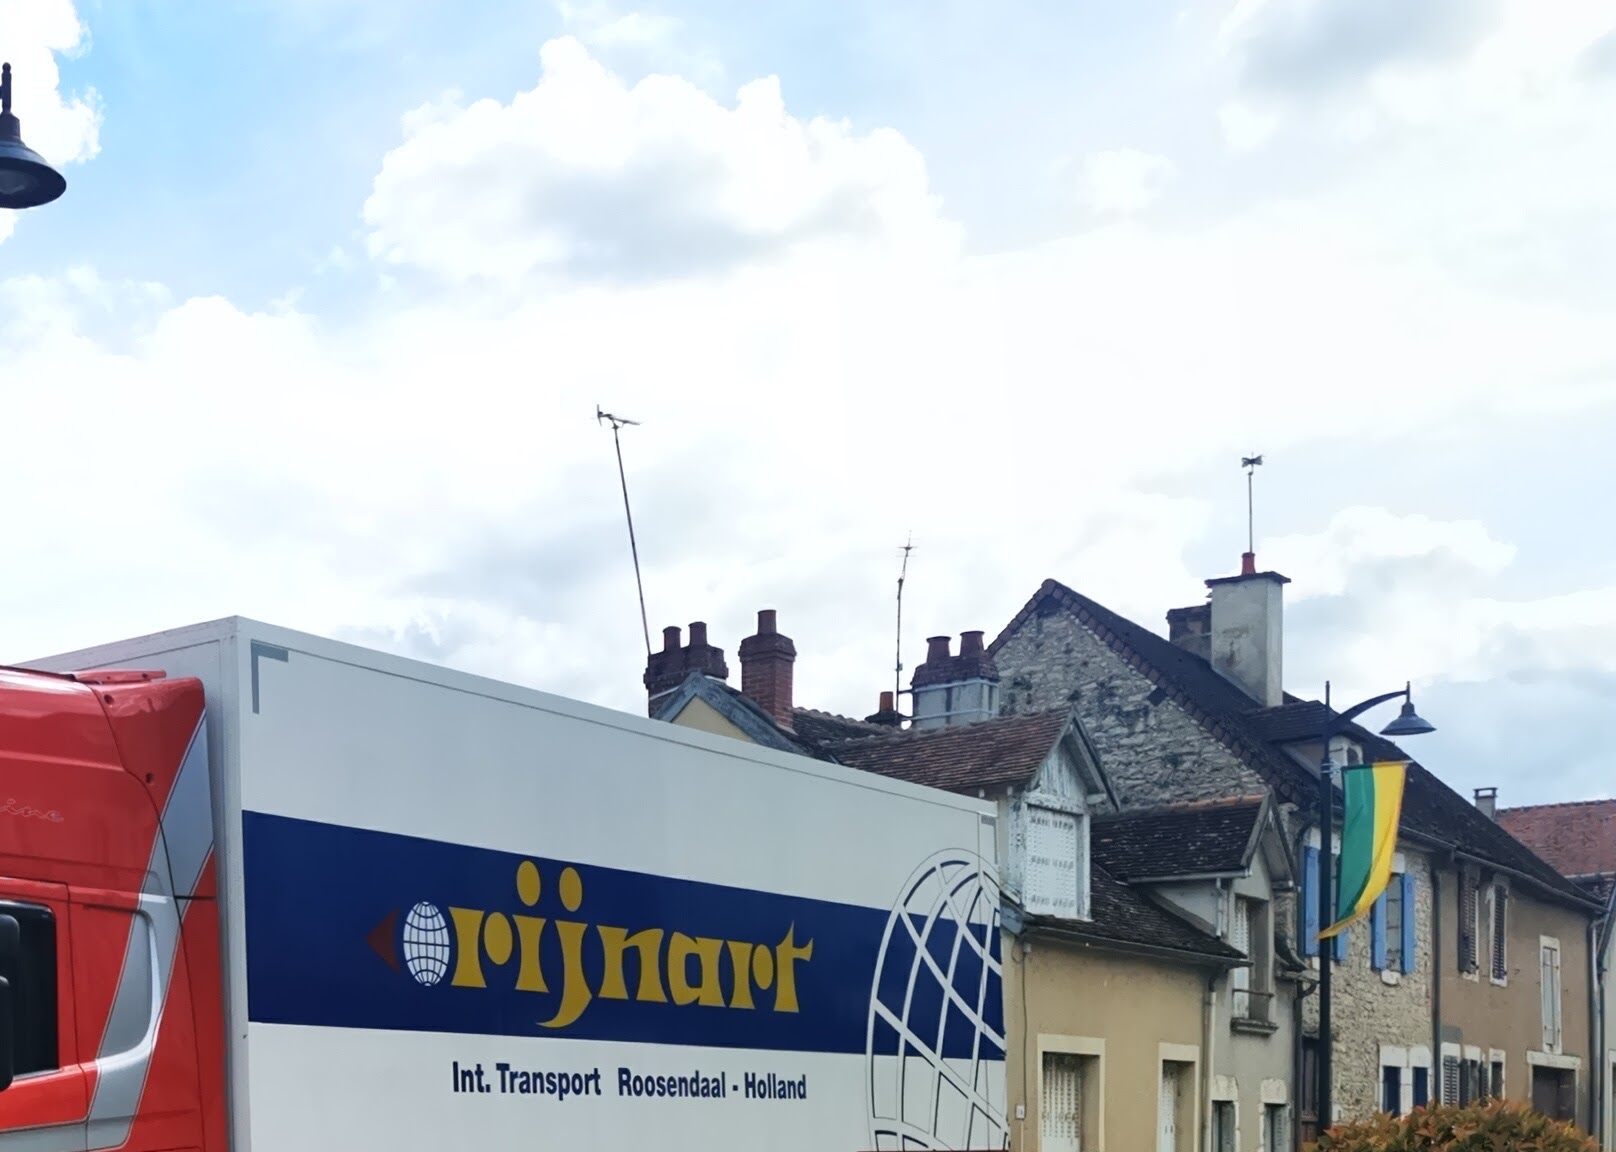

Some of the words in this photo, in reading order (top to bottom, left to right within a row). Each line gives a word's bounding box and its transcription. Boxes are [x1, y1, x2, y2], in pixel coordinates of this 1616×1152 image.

[448, 860, 813, 1028] rijnart
[453, 1061, 491, 1094] Int.
[496, 1063, 601, 1101] Transport
[618, 1067, 726, 1099] Roosendaal
[744, 1072, 807, 1099] Holland
